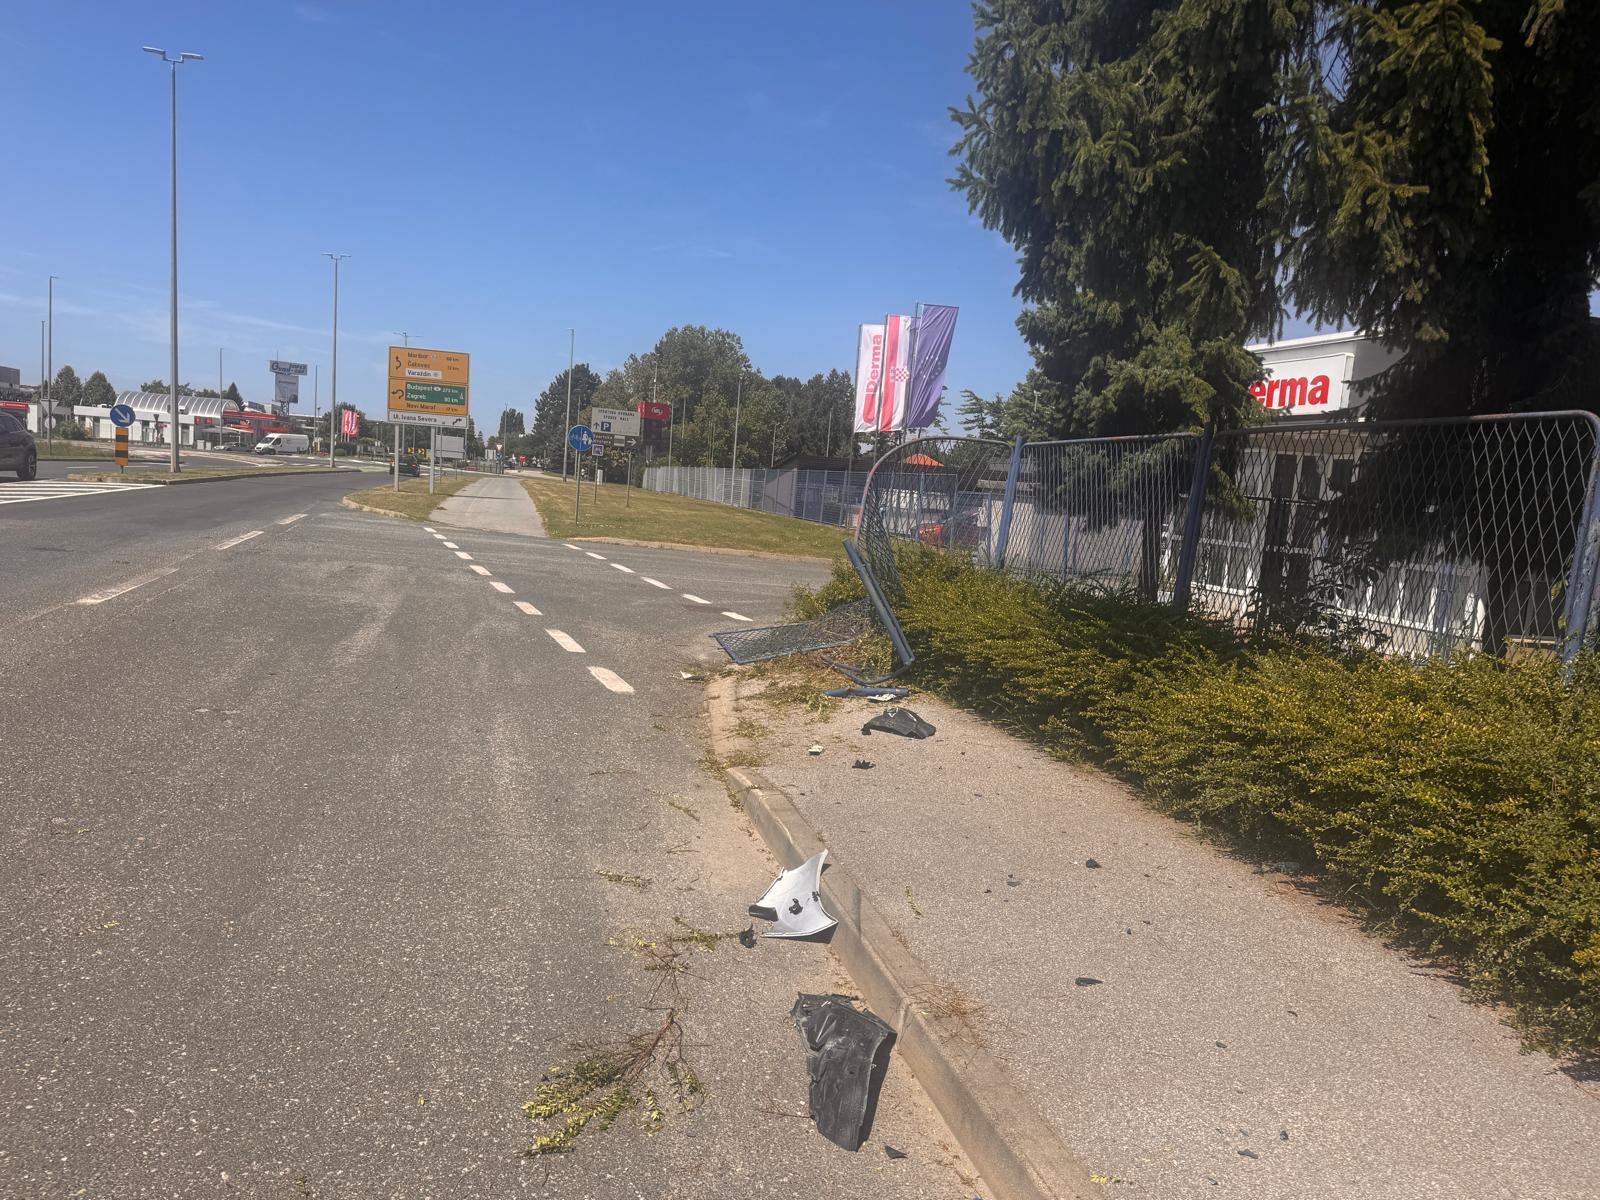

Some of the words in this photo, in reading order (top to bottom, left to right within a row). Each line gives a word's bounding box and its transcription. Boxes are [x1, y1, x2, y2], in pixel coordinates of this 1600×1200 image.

[865, 335, 882, 393] Derma
[1249, 375, 1330, 408] erma
[418, 415, 437, 423] Severa
